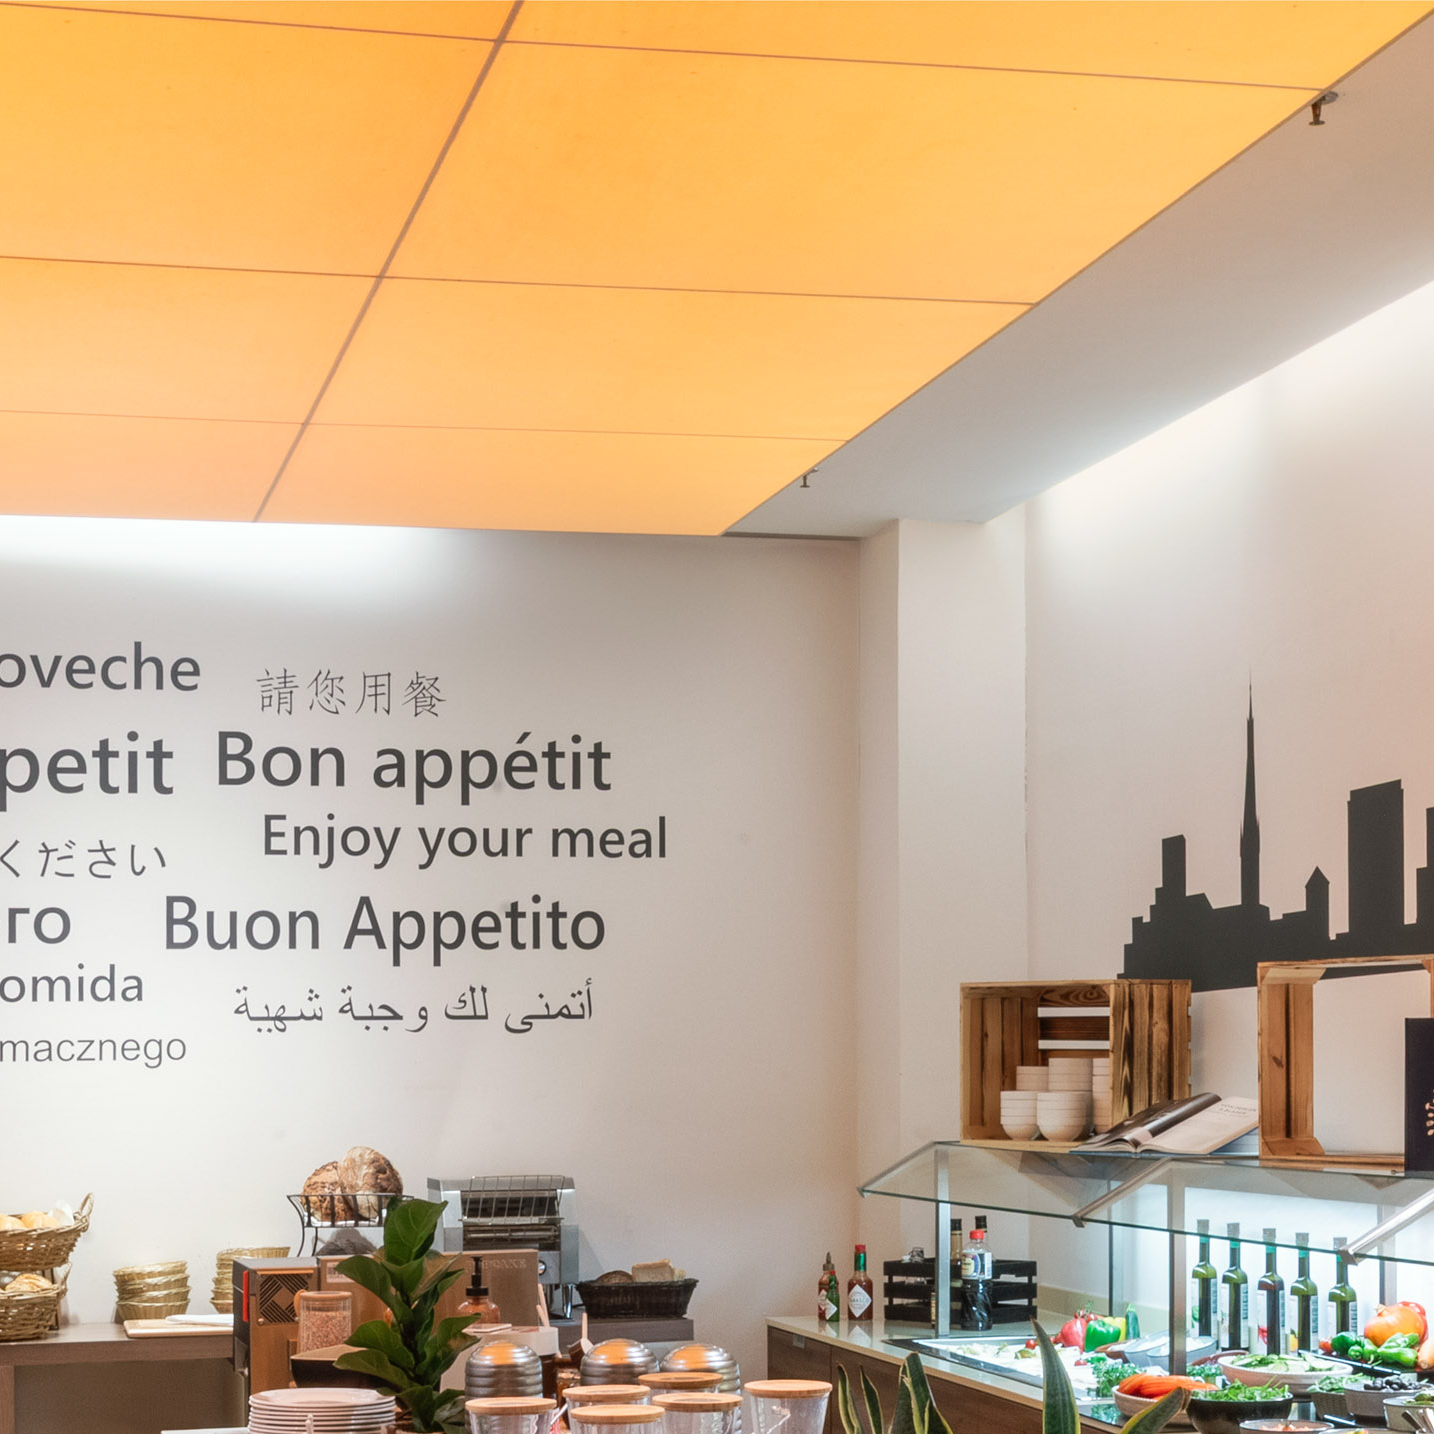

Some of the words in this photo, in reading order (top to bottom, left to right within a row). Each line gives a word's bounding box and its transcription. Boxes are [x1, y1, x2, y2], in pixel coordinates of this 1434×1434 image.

[256, 667, 447, 718] 請您用餐
[218, 730, 346, 788] Bon
[372, 731, 612, 807] appétit
[263, 812, 402, 870] Enjoy
[417, 826, 534, 871] your
[551, 815, 667, 859] meal
[165, 895, 320, 951] Buon
[342, 893, 606, 968] Appetito
[233, 985, 324, 1034] شهية
[338, 984, 429, 1034] وجبة
[444, 984, 489, 1021] لك
[504, 977, 593, 1035] أتمنى
